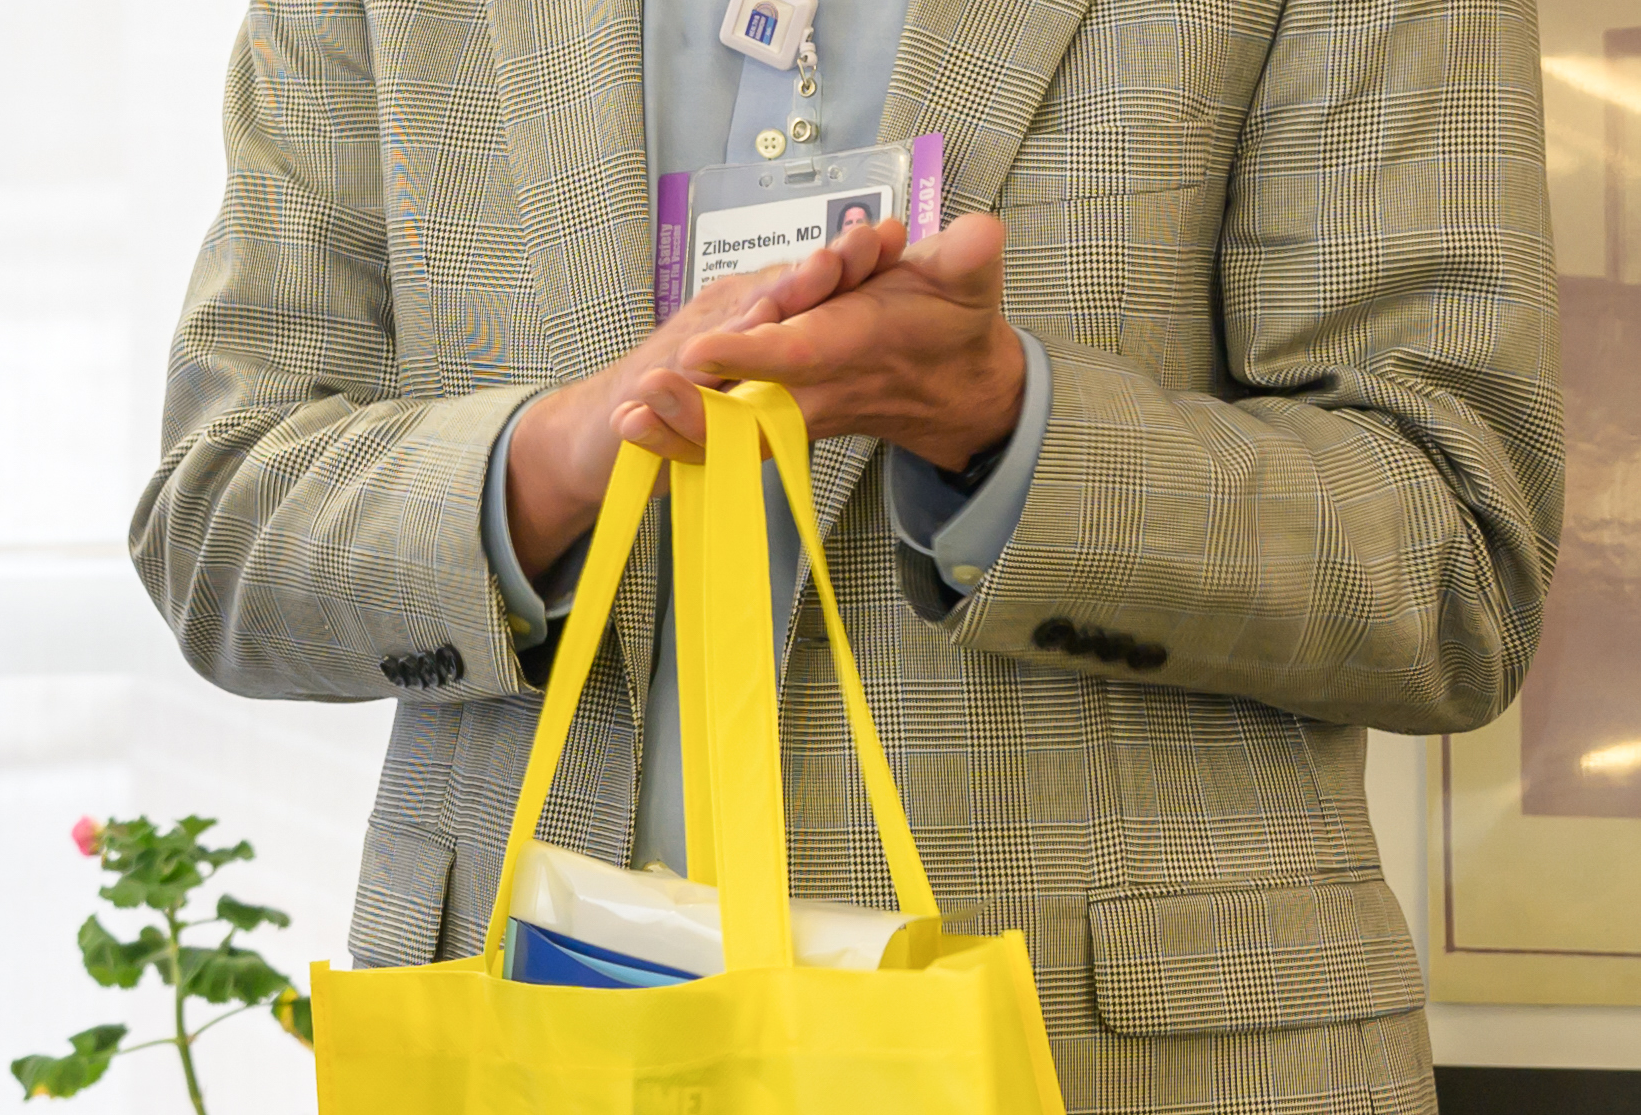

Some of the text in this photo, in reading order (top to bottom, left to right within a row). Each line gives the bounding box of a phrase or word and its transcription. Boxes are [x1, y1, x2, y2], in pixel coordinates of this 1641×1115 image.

[918, 176, 935, 224] 2025
[658, 223, 673, 265] Safety
[702, 225, 822, 256] Zilberstein, MD
[702, 259, 739, 272] Jeffrey
[658, 268, 671, 297] Your
